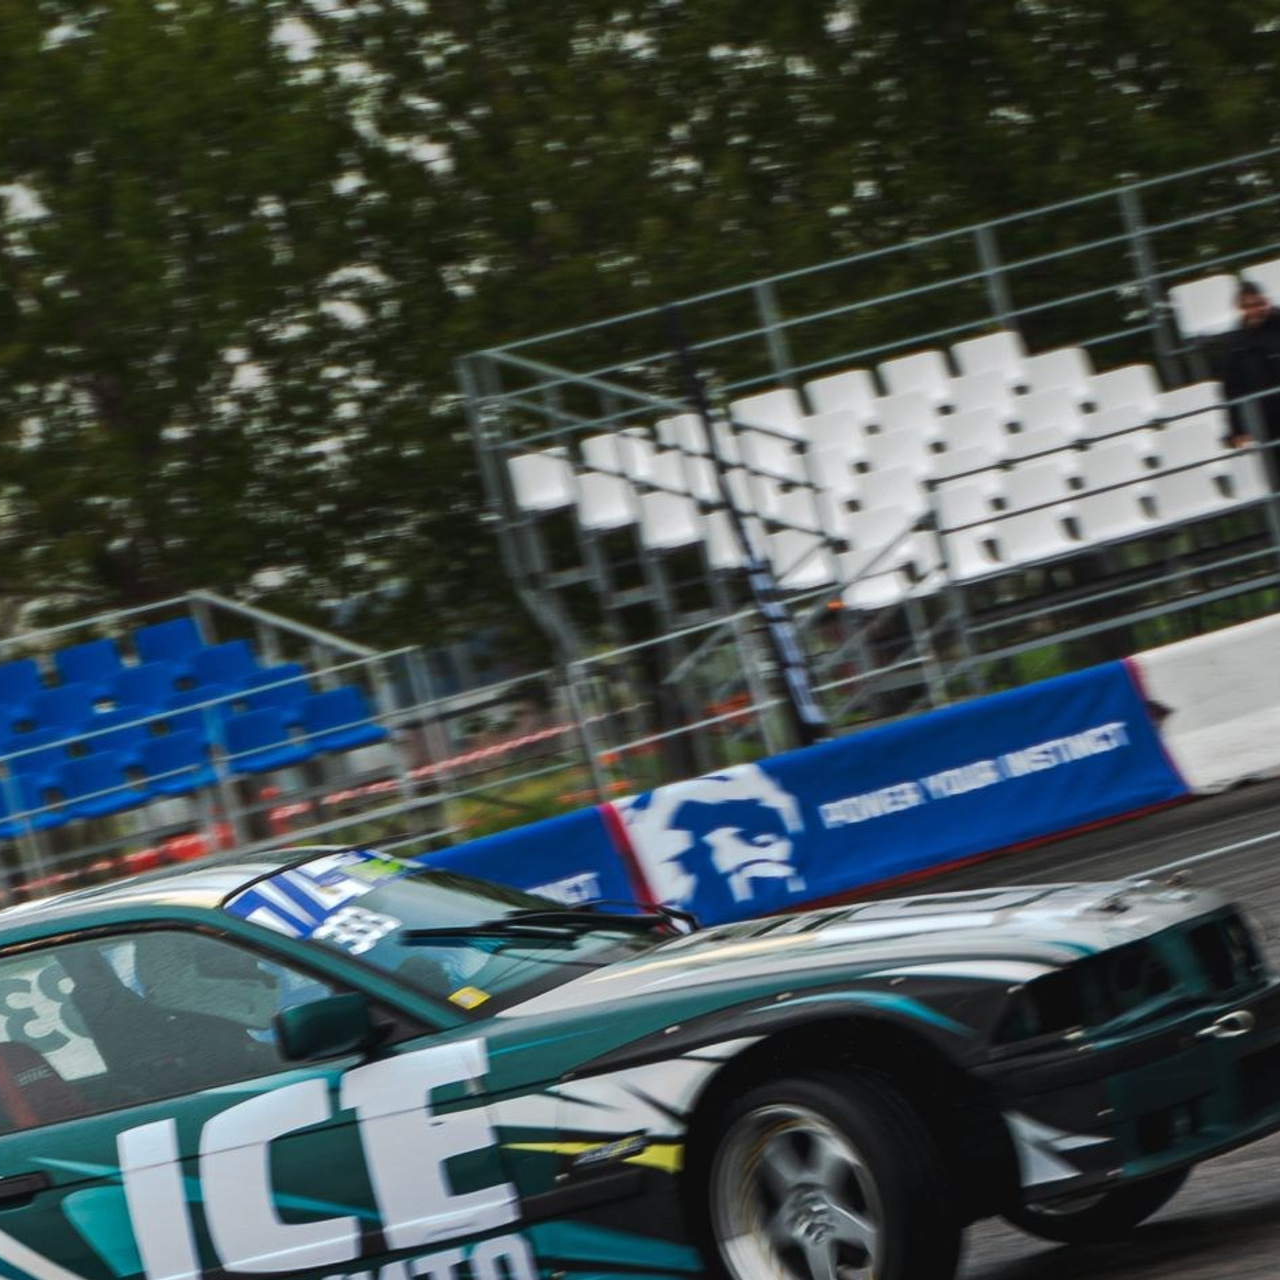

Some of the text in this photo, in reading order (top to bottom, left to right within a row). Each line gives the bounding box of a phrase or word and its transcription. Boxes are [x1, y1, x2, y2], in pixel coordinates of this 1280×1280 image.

[818, 722, 1131, 829] POWER YOUR INSTINCT
